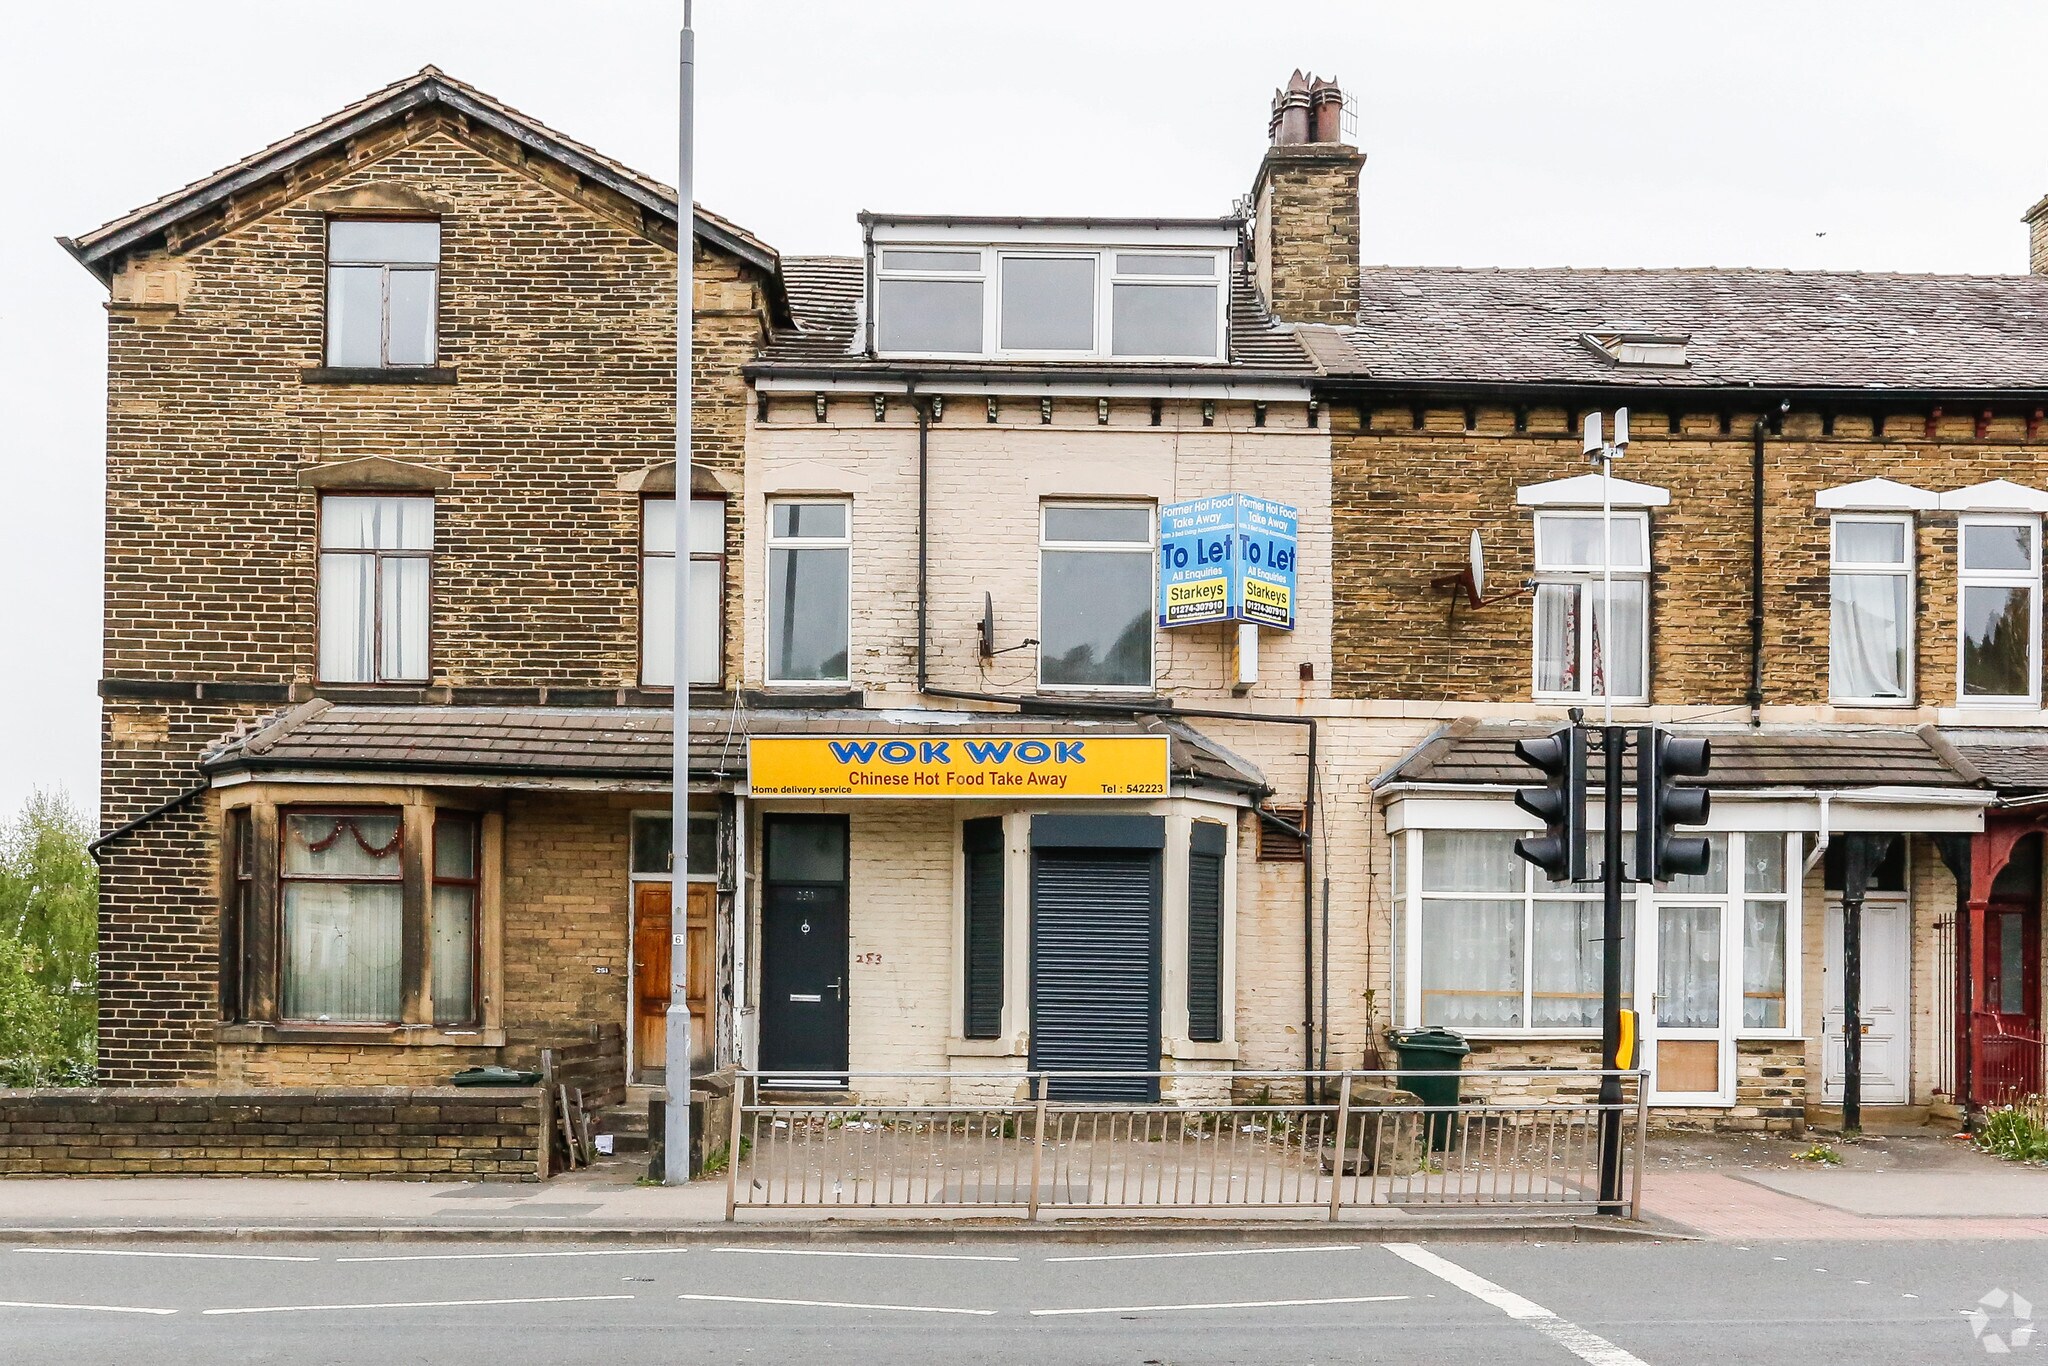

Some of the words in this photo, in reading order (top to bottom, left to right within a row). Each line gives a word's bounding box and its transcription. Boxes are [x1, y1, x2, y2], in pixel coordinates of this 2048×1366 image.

[1162, 505, 1193, 518] Former
[1194, 500, 1209, 512] Hot
[1211, 495, 1234, 509] Food
[1239, 495, 1265, 511] Former
[1265, 502, 1279, 515] Hot
[1279, 506, 1297, 520] Food
[1173, 516, 1194, 529] Take
[1195, 513, 1222, 525] Away
[1248, 511, 1267, 525] Take
[1267, 516, 1288, 533] Away
[1162, 543, 1189, 570] To
[1197, 534, 1233, 565] Let
[1239, 533, 1261, 564] To
[1267, 540, 1296, 572] Let
[1171, 571, 1184, 582] All
[1185, 567, 1223, 580] Enquiries
[1247, 565, 1257, 576] All
[1257, 567, 1287, 583] Enquiries
[1171, 584, 1224, 601] Starkeys
[1246, 581, 1287, 605] Starkeys
[1170, 600, 1223, 615] 01274-307910
[828, 741, 951, 764] WOK
[963, 741, 1086, 764] WOK
[849, 771, 909, 786] Chinese
[914, 772, 940, 786] Hot
[946, 771, 984, 786] Food
[989, 771, 1023, 786] Take
[1027, 771, 1067, 789] Away
[1101, 784, 1116, 794] Tel
[1126, 784, 1164, 794] 542223
[751, 786, 778, 794] Home
[780, 785, 817, 795] delivery
[819, 785, 852, 794] service
[675, 935, 681, 944] 6
[856, 952, 882, 965] 253
